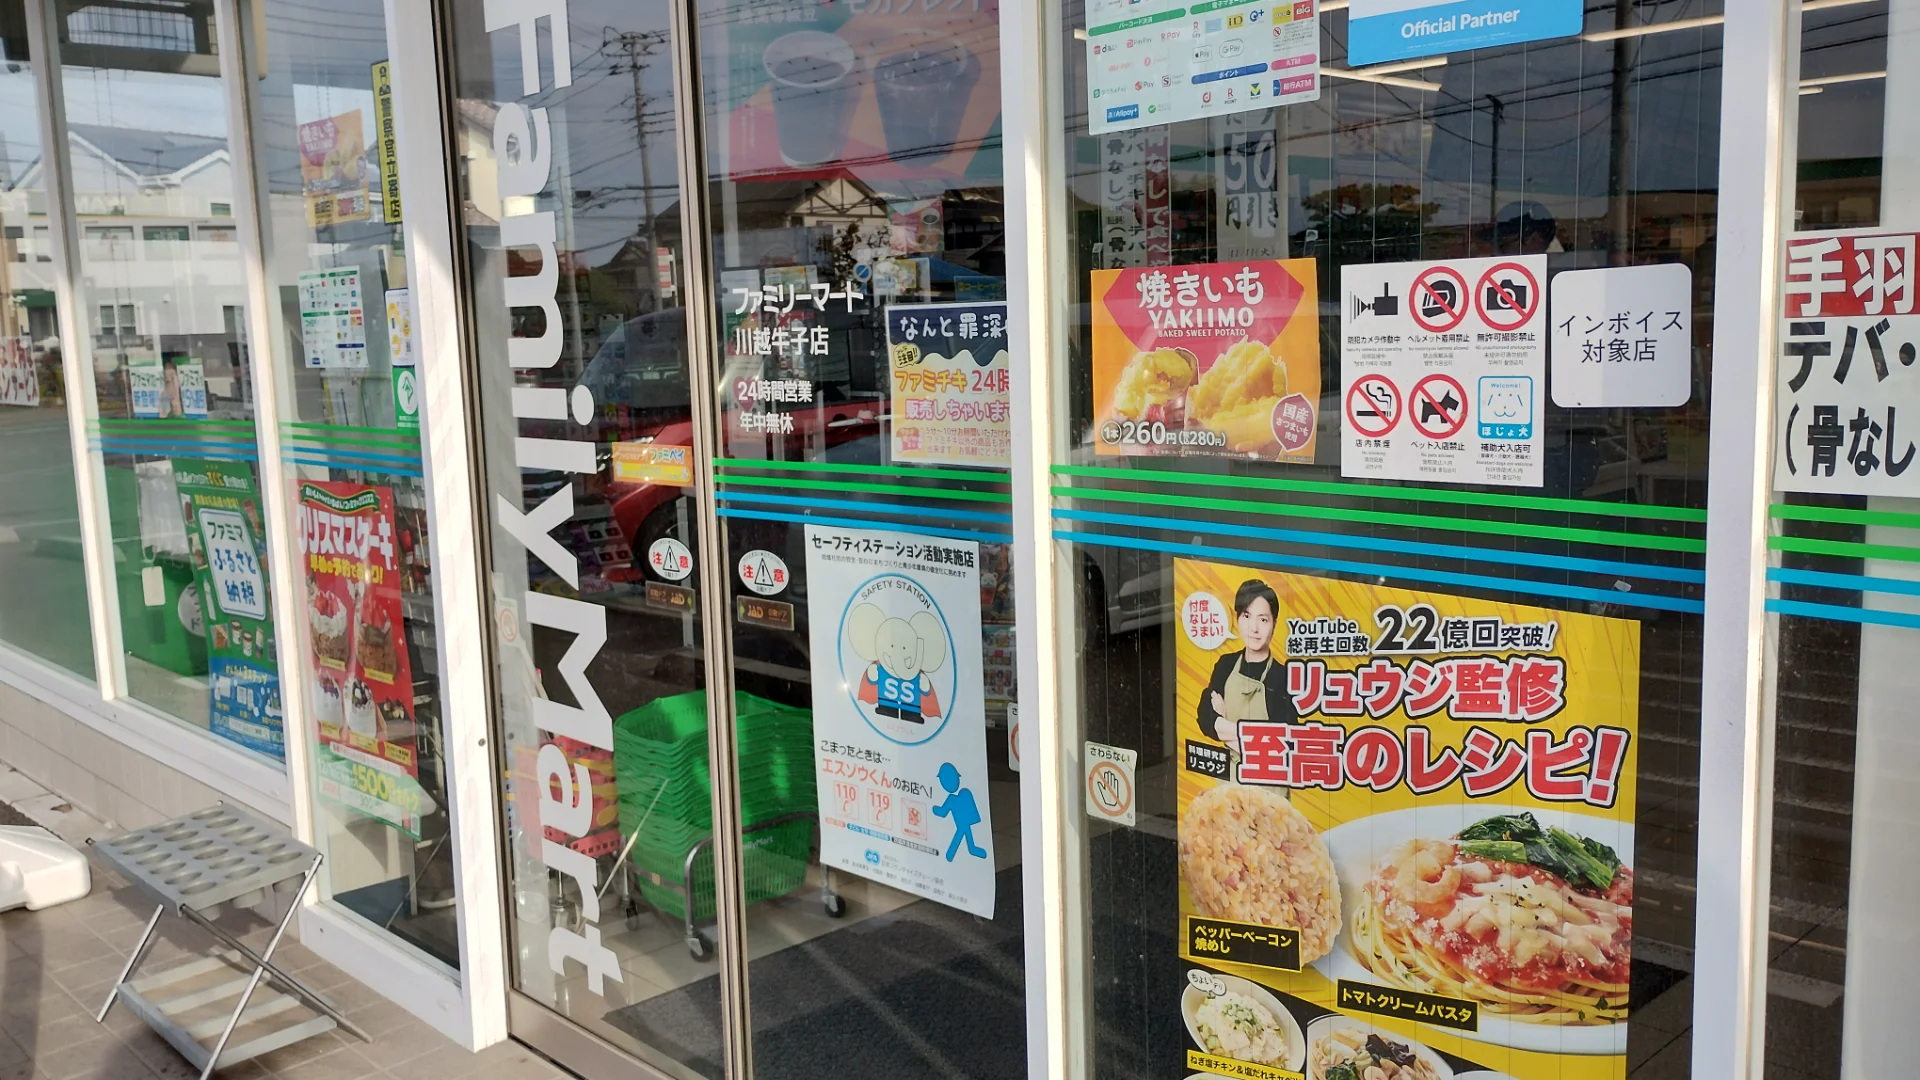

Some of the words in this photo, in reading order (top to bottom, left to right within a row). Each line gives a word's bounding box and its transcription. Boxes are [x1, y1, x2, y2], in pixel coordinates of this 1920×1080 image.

[1401, 16, 1456, 38] Official
[1460, 8, 1520, 30] Partner
[1785, 235, 1917, 316] 手羽
[732, 281, 863, 314] ファミリーマート
[1136, 266, 1264, 308] 焼きいも
[1149, 307, 1254, 329] YAKIIMO
[1558, 309, 1684, 337] インボイス
[735, 325, 829, 356] 川越牛子店
[1158, 329, 1183, 338] BAKED
[1186, 329, 1211, 337] SWEET
[1215, 328, 1246, 337] POTATO
[1347, 335, 1401, 344] 防犯カメラ作動中
[1408, 333, 1470, 343] ヘルメット着用禁止
[1477, 332, 1536, 342] 無許可撮影禁止
[1581, 336, 1658, 364] 対象店
[1784, 318, 1917, 393] テバ・
[738, 380, 813, 402] 24時間営業
[740, 412, 794, 434] 年中無休
[1283, 402, 1309, 425] 国産
[1482, 427, 1529, 437] ほじょ犬
[1785, 402, 1917, 477] (骨なし
[1355, 439, 1391, 449] 店内禁煙
[1410, 441, 1465, 451] ペット入店禁止
[1480, 443, 1531, 453] 補助犬入店可
[651, 448, 685, 464] ファミペイ
[483, 0, 624, 997] FamilyMart
[207, 521, 244, 543] ファミマ
[296, 503, 394, 571] クリスマスケーキ
[213, 549, 256, 574] ふるさと
[811, 534, 974, 568] セーフティステーション活動実施店
[310, 554, 383, 585] 早めの予約でおク!
[225, 579, 256, 606] 納税
[861, 580, 893, 600] SAFETY
[896, 580, 931, 609] STATION
[1189, 600, 1209, 613] 忖度
[1189, 613, 1219, 625] なしに
[1288, 619, 1358, 635] YouTube
[1191, 625, 1225, 638] うまい!
[1287, 636, 1369, 655] 総再生回数
[884, 678, 915, 703] SS
[1287, 658, 1562, 719] リュウジ監修
[1090, 747, 1130, 762] さわらない
[1188, 744, 1227, 762] 料理研究家
[1240, 721, 1627, 806] 至高のレシピ!
[1189, 756, 1226, 774] リュウジ
[836, 783, 856, 801] 110
[870, 792, 890, 810] 119
[1194, 924, 1293, 949] ペッパーベーコン
[1194, 938, 1231, 955] 焼めし
[1191, 973, 1213, 986] ちょい
[1342, 987, 1473, 1023] トマトクリームパスタ
